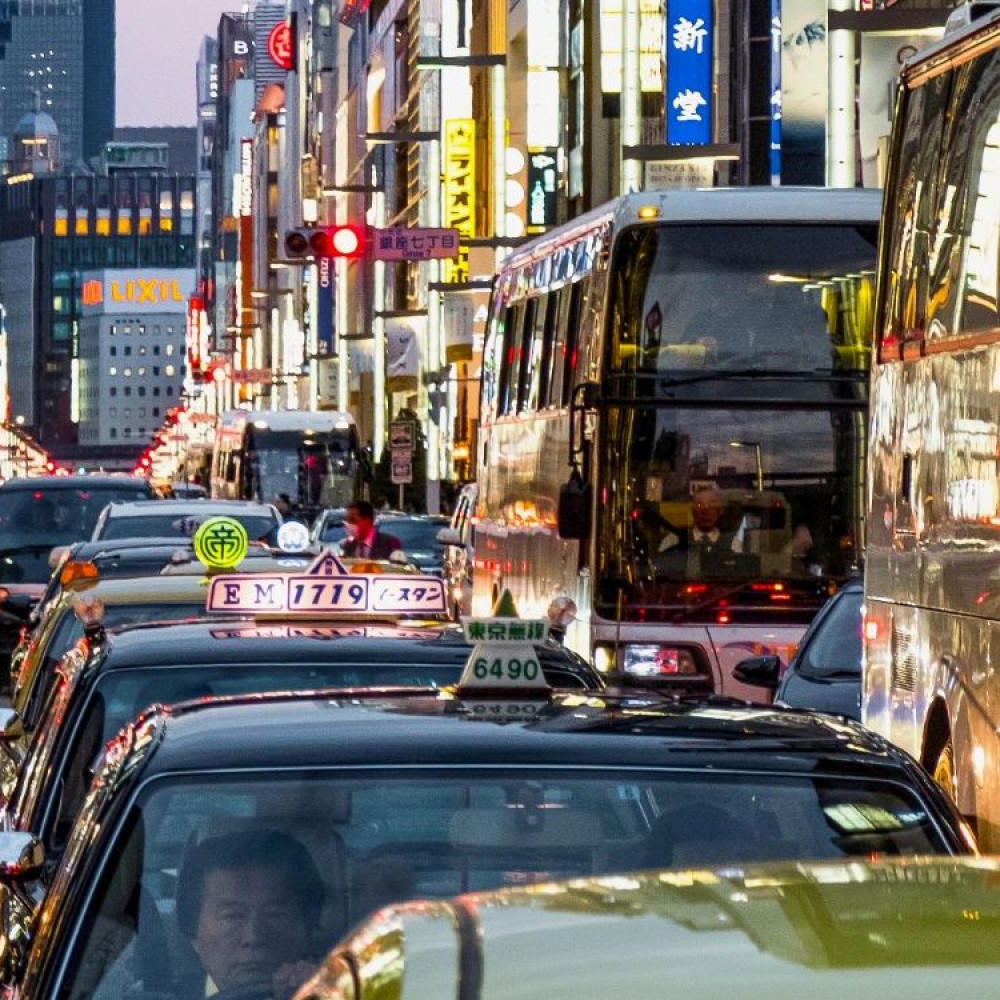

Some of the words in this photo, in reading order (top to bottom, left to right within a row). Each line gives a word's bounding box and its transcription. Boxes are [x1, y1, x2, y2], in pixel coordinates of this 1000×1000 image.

[111, 278, 185, 304] LIXIL
[293, 584, 364, 604] 1719
[380, 586, 441, 601] イースタン
[473, 657, 538, 681] 6490
